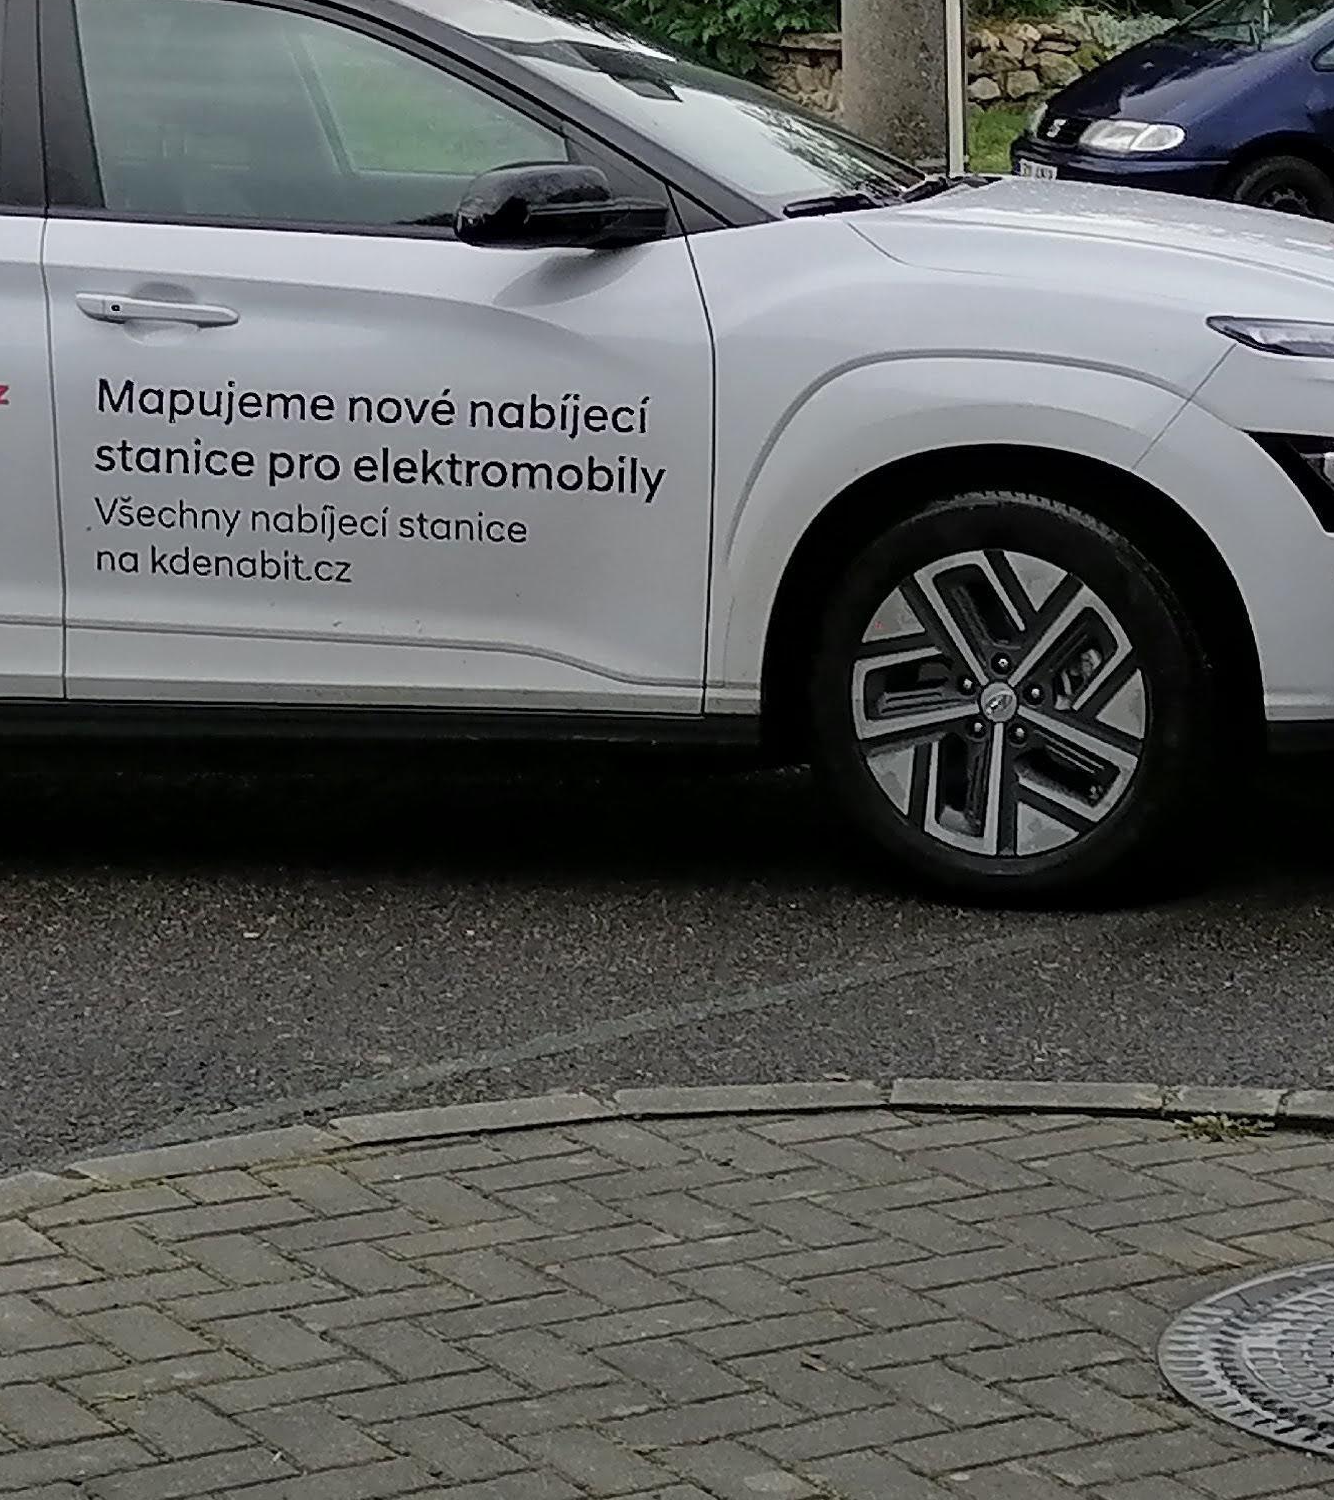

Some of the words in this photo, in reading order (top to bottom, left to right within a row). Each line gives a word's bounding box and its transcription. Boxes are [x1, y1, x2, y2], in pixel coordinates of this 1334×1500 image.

[97, 378, 335, 425] Mapujeme
[348, 388, 456, 426] nové
[469, 393, 650, 439] nabíjecí
[94, 438, 255, 477] stanice
[269, 451, 341, 487] pro
[353, 446, 667, 504] elektromobily
[94, 495, 241, 537] Všechny
[251, 504, 389, 542] nabíjecí
[398, 511, 528, 543] stanice
[96, 550, 139, 573] na
[151, 545, 353, 583] kdenabit.cz
